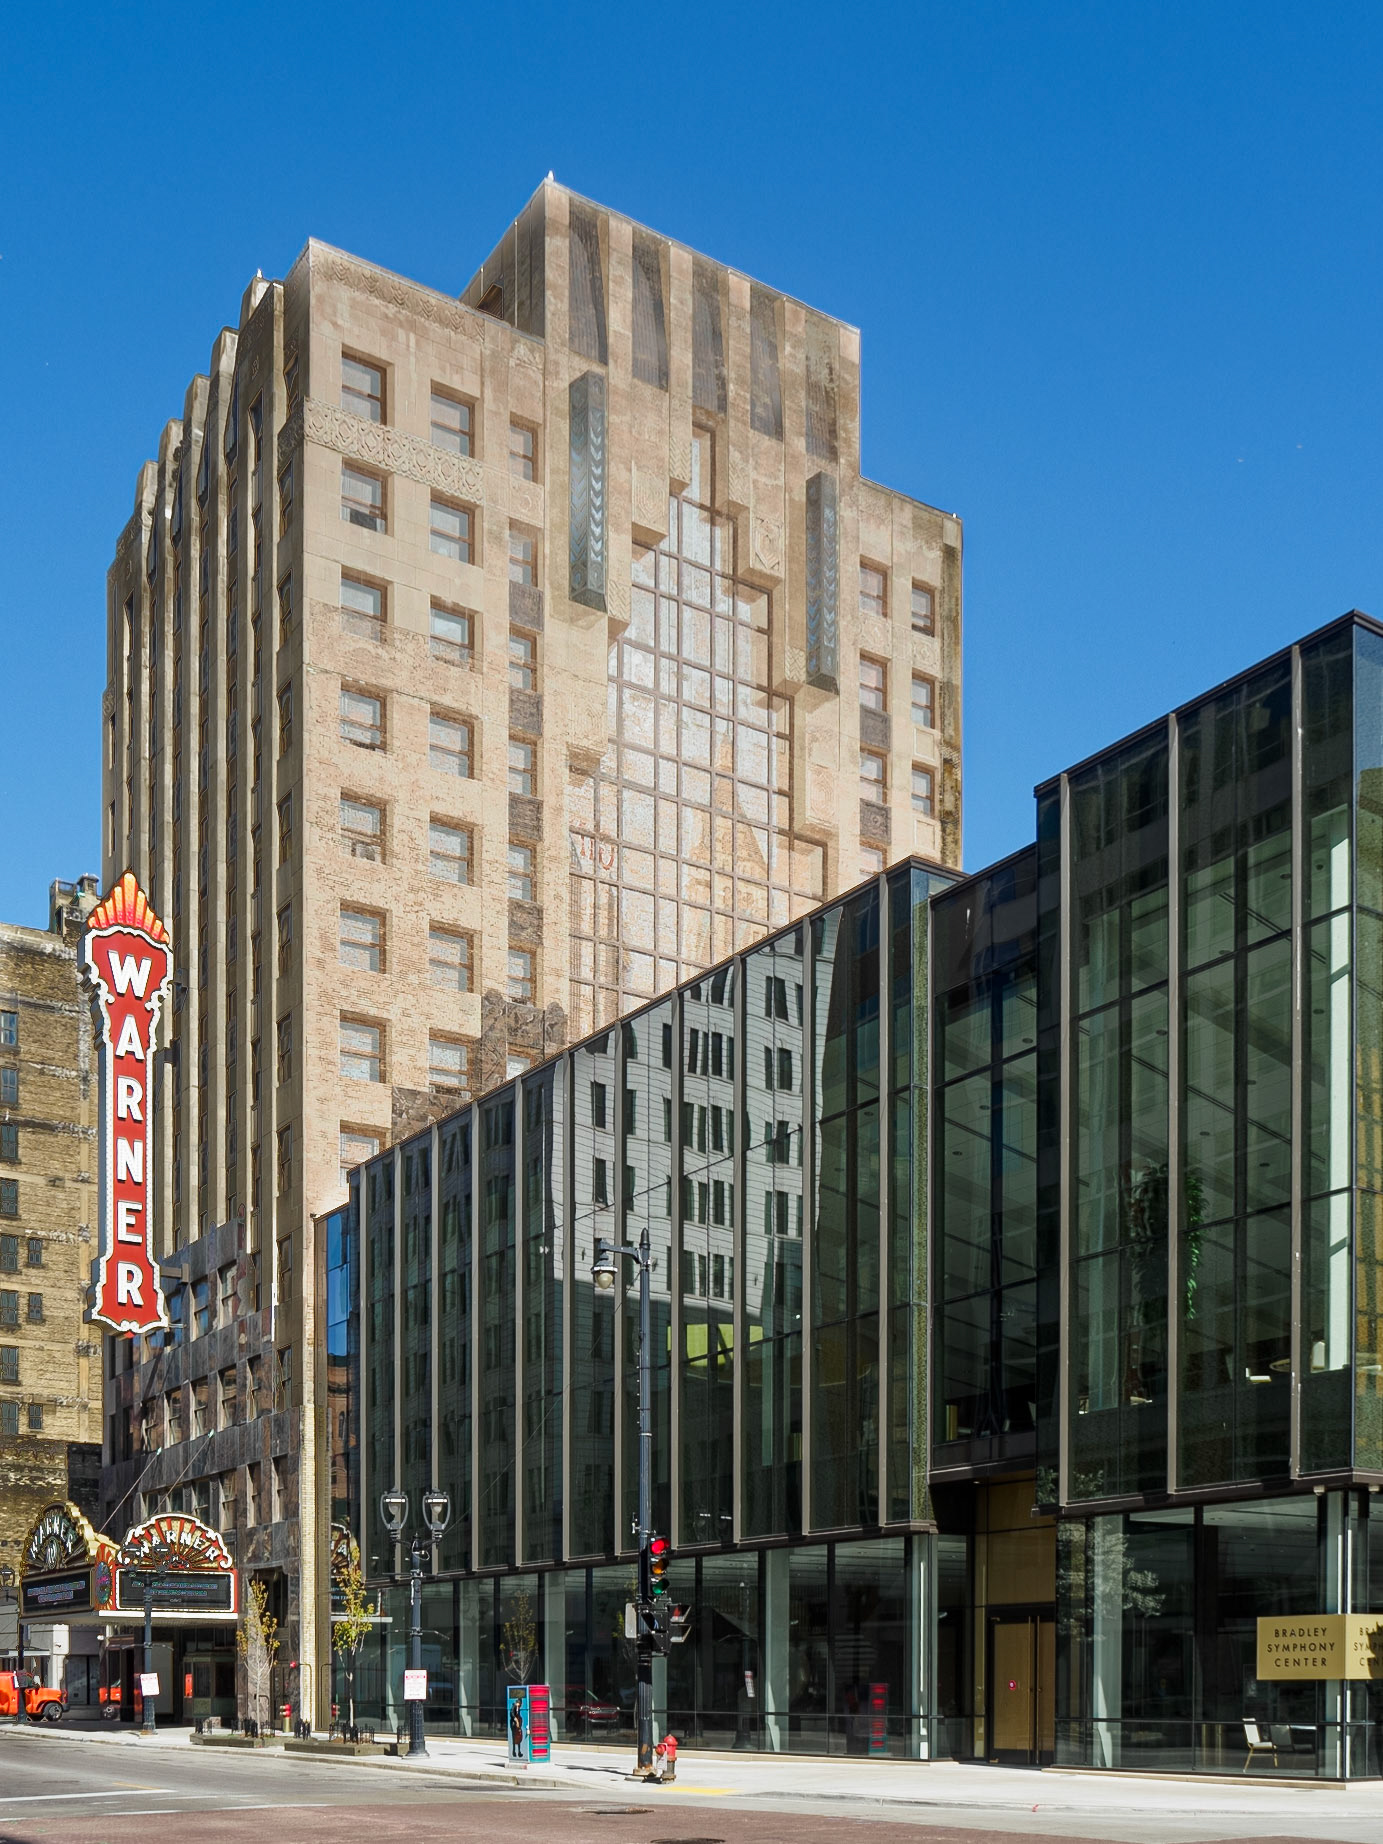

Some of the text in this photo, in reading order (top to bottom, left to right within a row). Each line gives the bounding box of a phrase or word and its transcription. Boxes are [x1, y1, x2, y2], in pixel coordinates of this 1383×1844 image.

[107, 949, 152, 1307] WARNER
[135, 1530, 218, 1561] WARNER
[1274, 1627, 1327, 1638] BRADLEY
[1267, 1642, 1335, 1653] SYMPHONY
[1274, 1657, 1327, 1668] CENTER
